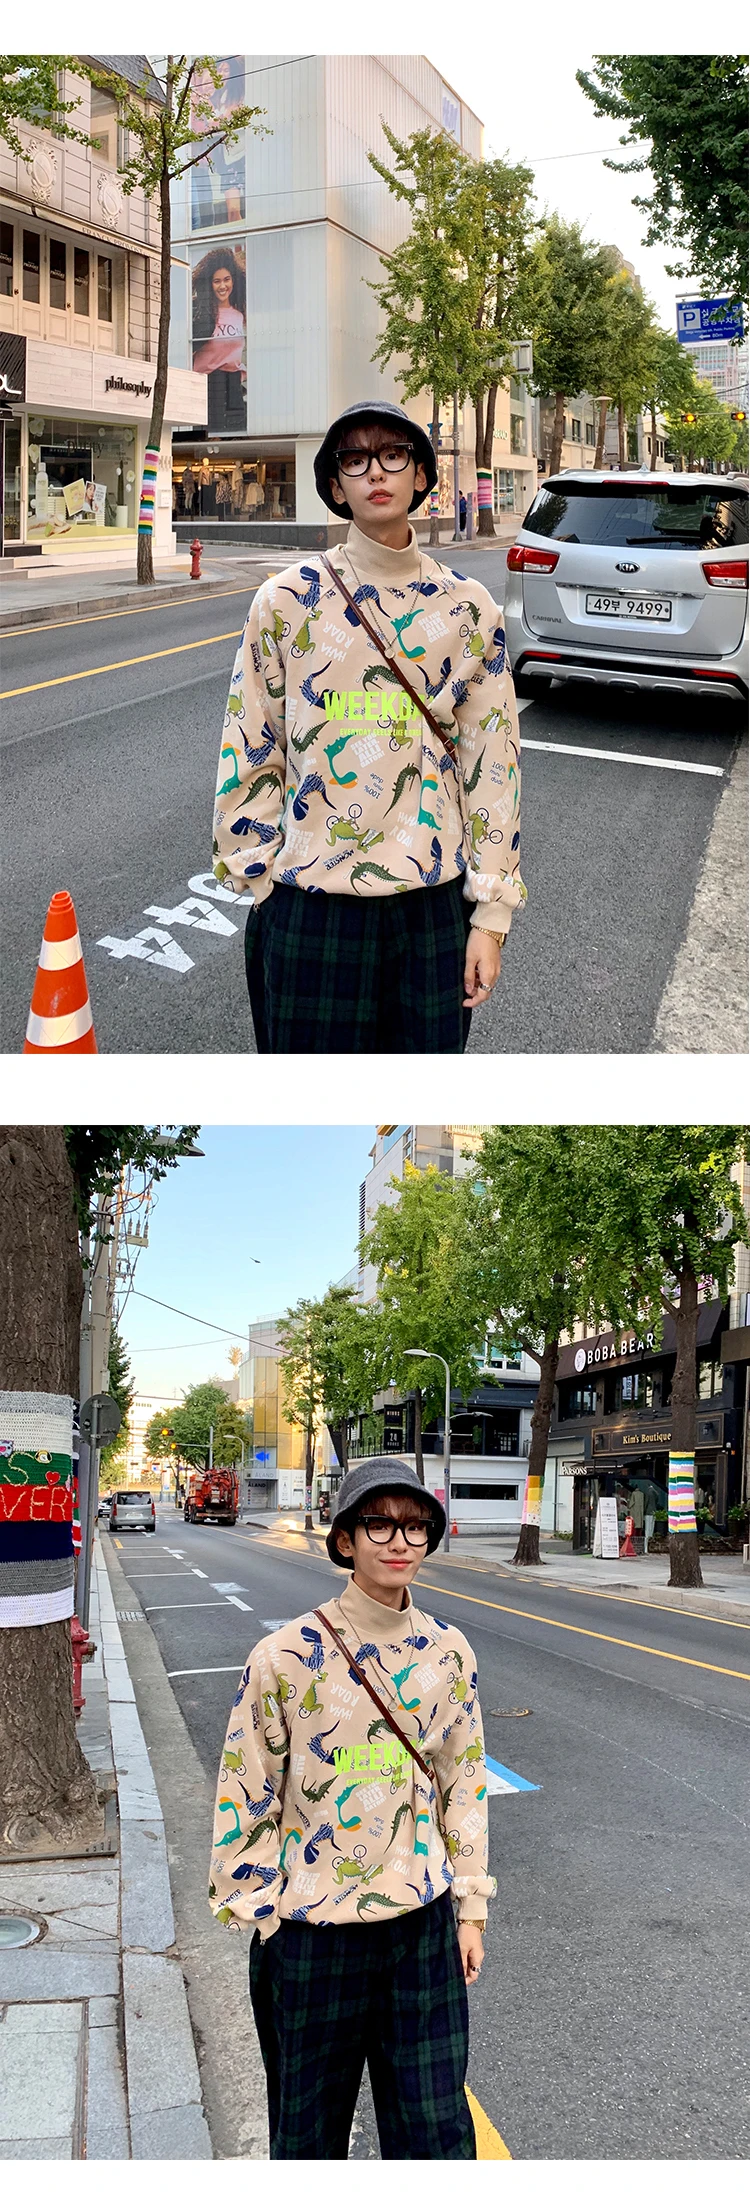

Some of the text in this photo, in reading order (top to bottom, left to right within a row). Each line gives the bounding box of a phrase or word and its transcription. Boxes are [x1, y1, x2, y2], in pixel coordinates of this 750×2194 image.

[105, 376, 152, 398] philosophy
[618, 563, 636, 572] KIA
[593, 598, 663, 616] 49부 9499
[532, 614, 563, 624] CARNIVAL
[587, 1333, 654, 1364] BOBA BEAR
[622, 1432, 672, 1445] Kim's Boutique
